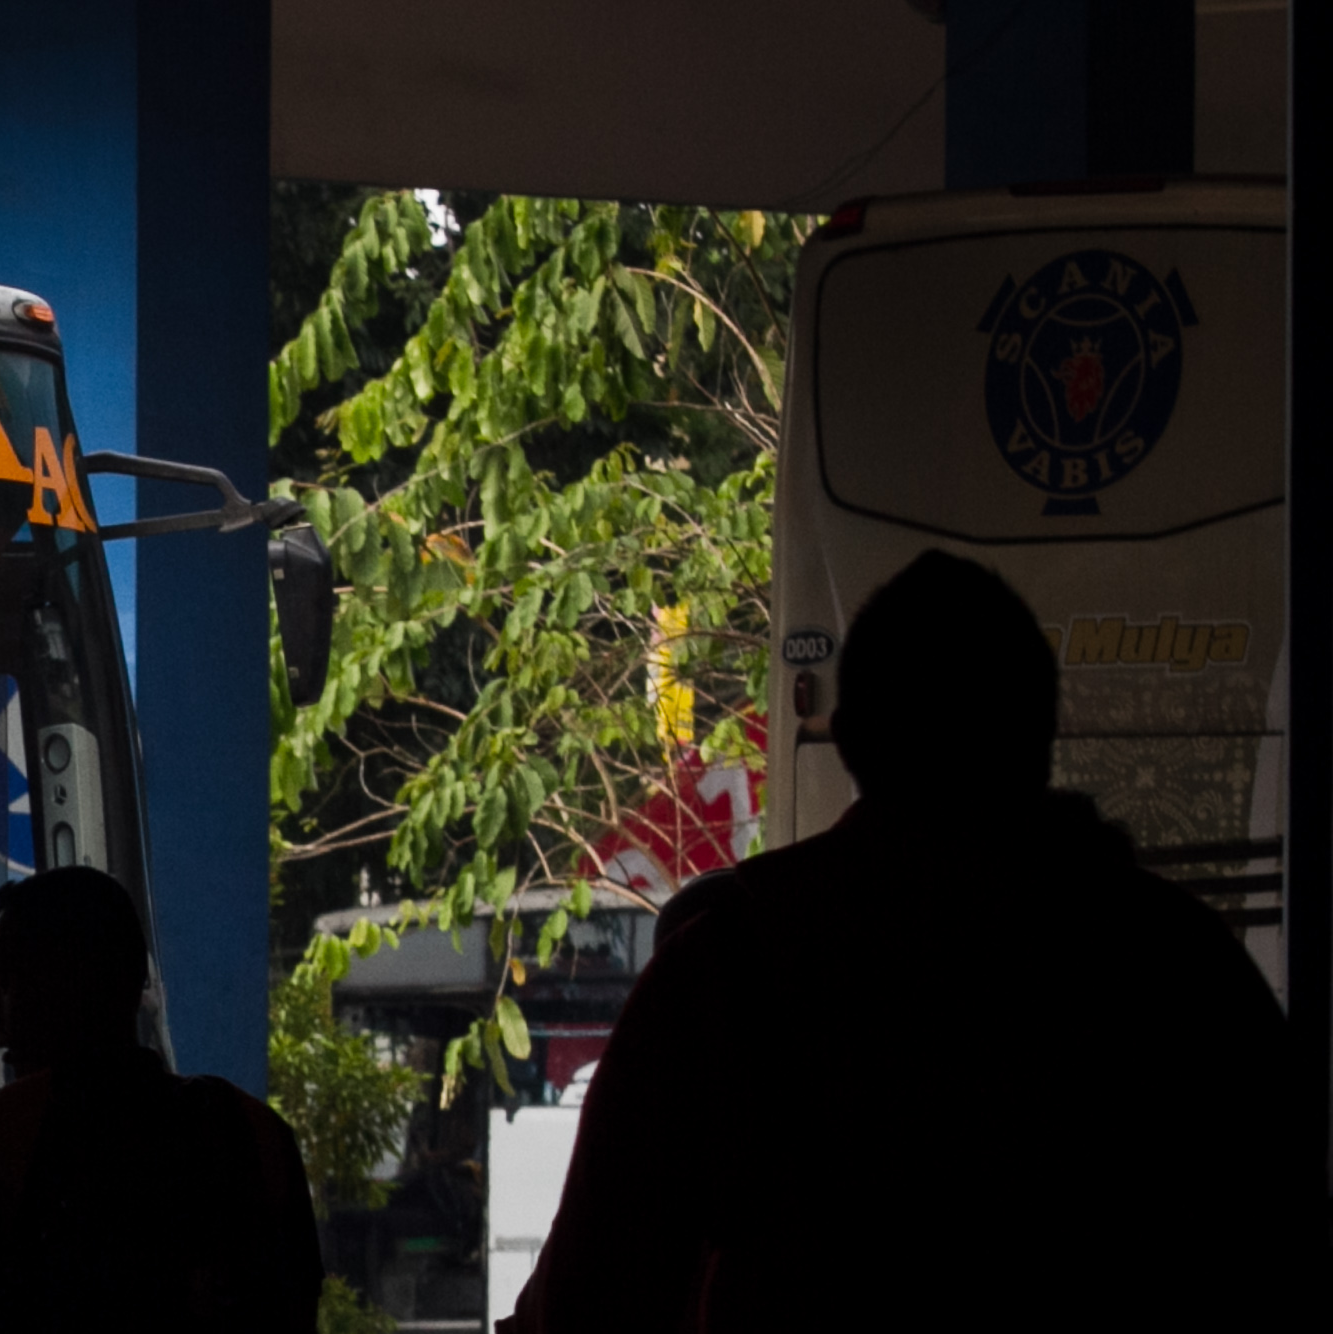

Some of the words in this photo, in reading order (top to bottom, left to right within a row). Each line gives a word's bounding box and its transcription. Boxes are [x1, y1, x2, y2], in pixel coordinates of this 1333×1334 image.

[994, 258, 1176, 369] SCANIA
[1006, 417, 1146, 488] VABIS
[1064, 615, 1250, 673] Mulya
